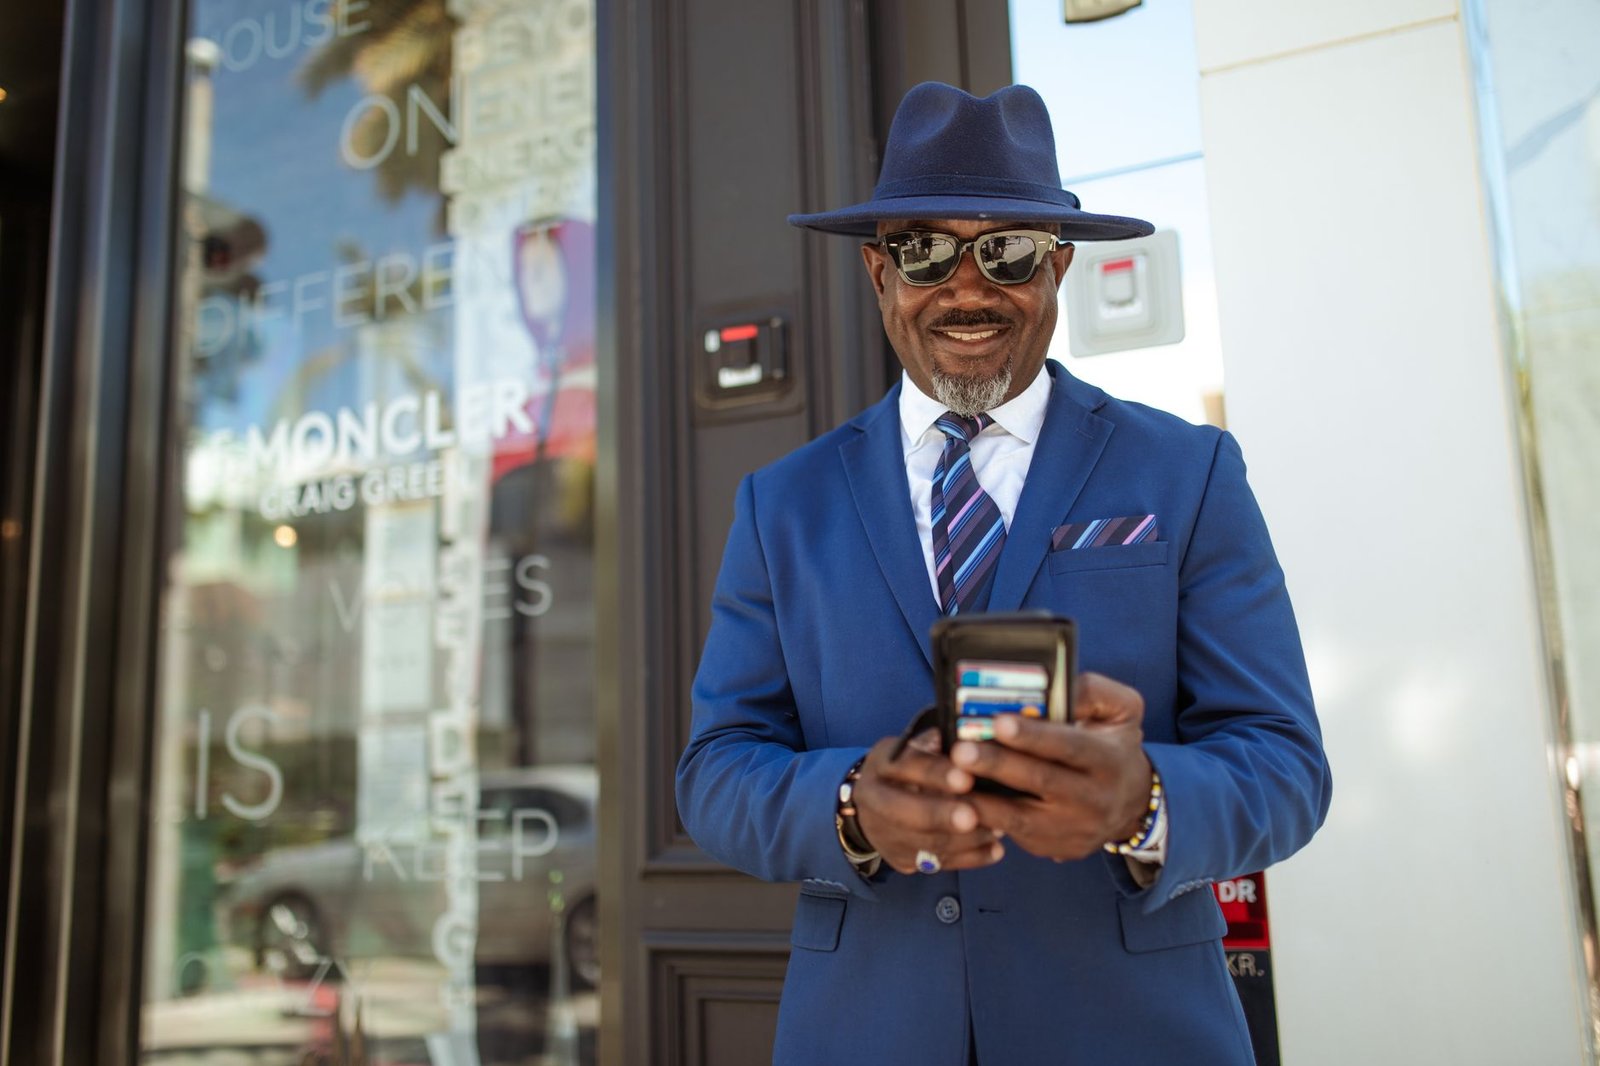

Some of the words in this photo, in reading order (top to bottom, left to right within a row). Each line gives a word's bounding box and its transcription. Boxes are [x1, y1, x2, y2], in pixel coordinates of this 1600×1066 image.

[208, 0, 371, 78] OUSE
[244, 378, 534, 476] MONCLER
[259, 473, 356, 521] CRAIG
[194, 704, 285, 820] IS
[1218, 879, 1257, 904] DR
